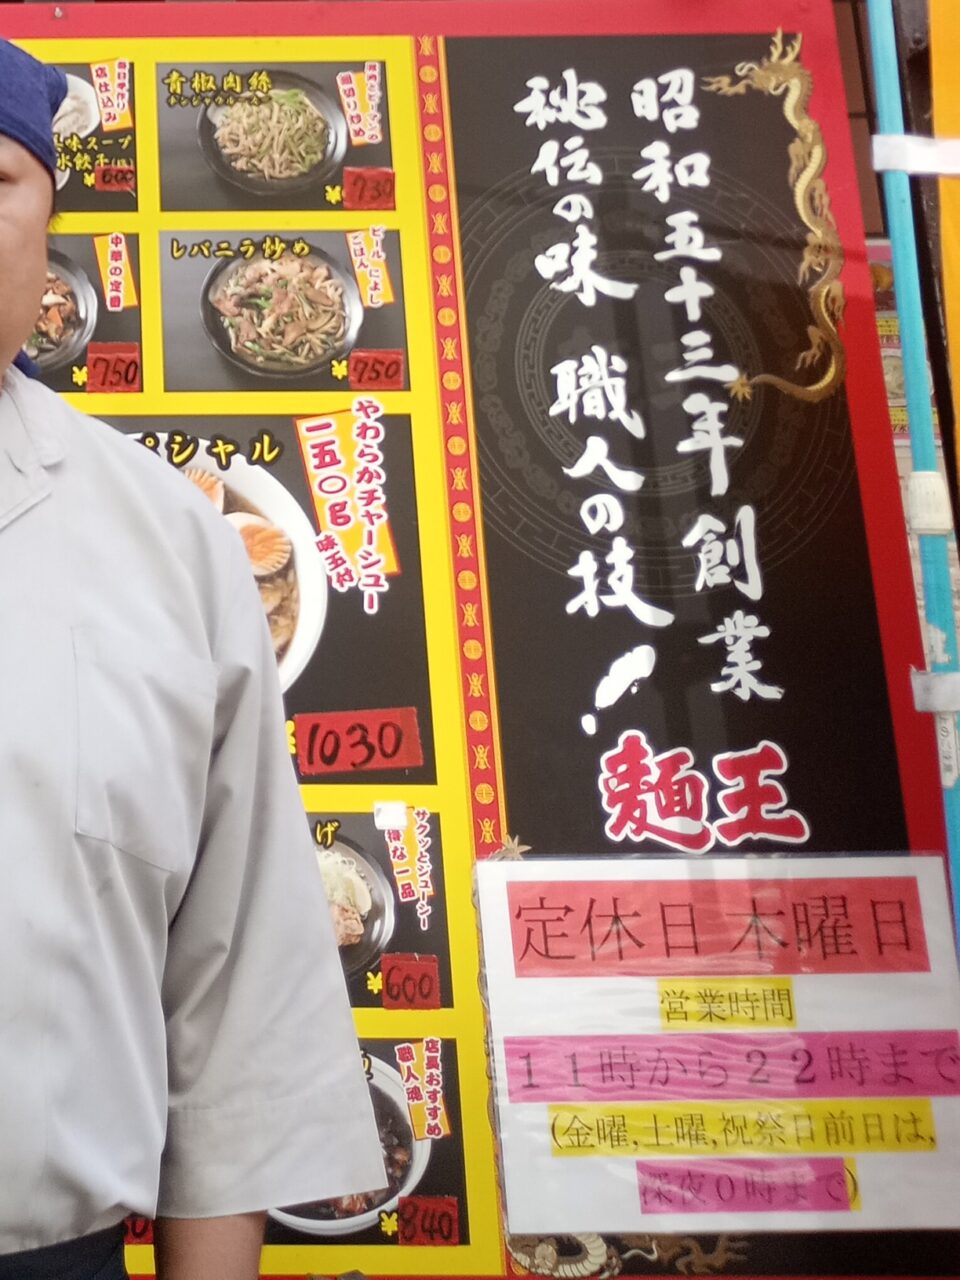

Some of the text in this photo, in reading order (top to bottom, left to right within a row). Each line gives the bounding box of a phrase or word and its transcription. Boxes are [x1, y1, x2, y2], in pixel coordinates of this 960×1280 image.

[171, 236, 312, 261] レバニラ炒め
[513, 67, 639, 306] 秘伝の味
[630, 67, 786, 702] 昭和五十三年創業
[355, 400, 386, 610] やわらかチャーシュー
[600, 730, 810, 854] 麺王
[659, 987, 794, 1022] 営業時間
